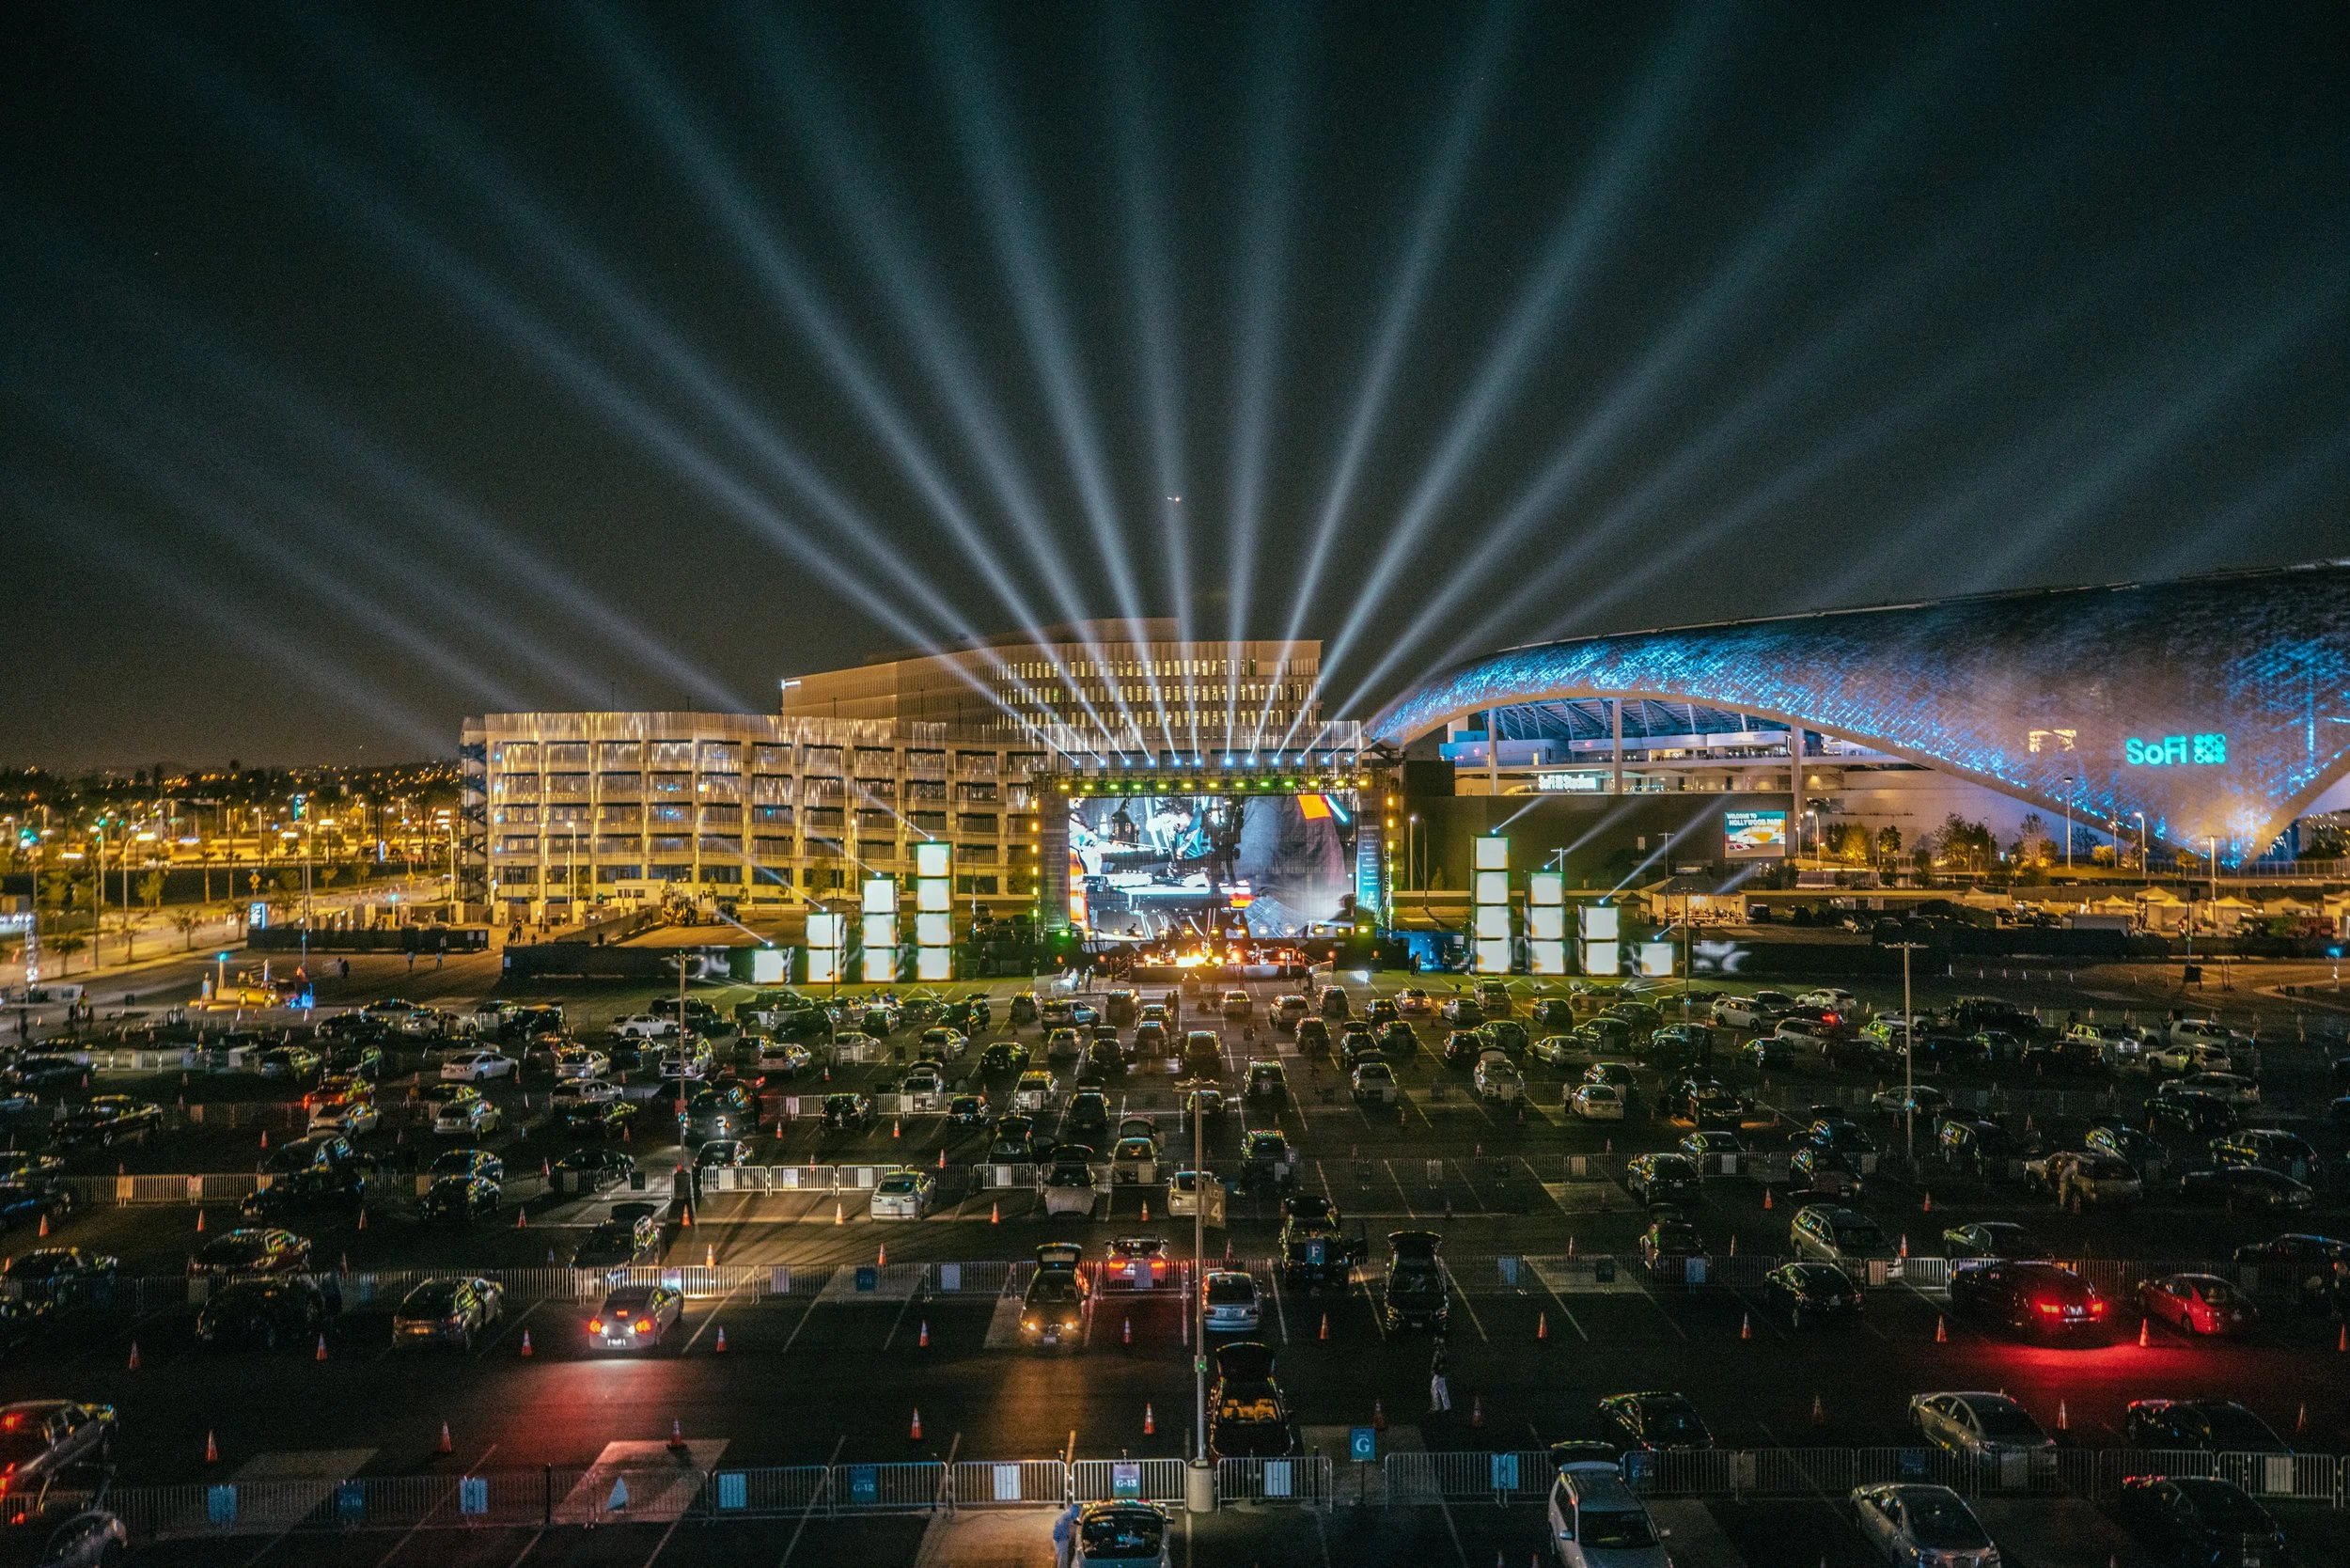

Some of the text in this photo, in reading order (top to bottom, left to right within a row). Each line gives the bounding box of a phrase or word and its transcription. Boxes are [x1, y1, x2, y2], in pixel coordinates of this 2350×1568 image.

[2125, 735, 2187, 765] SoFi
[1210, 1201, 1222, 1222] 4
[1311, 1245, 1321, 1258] F
[1355, 1437, 1371, 1452] G
